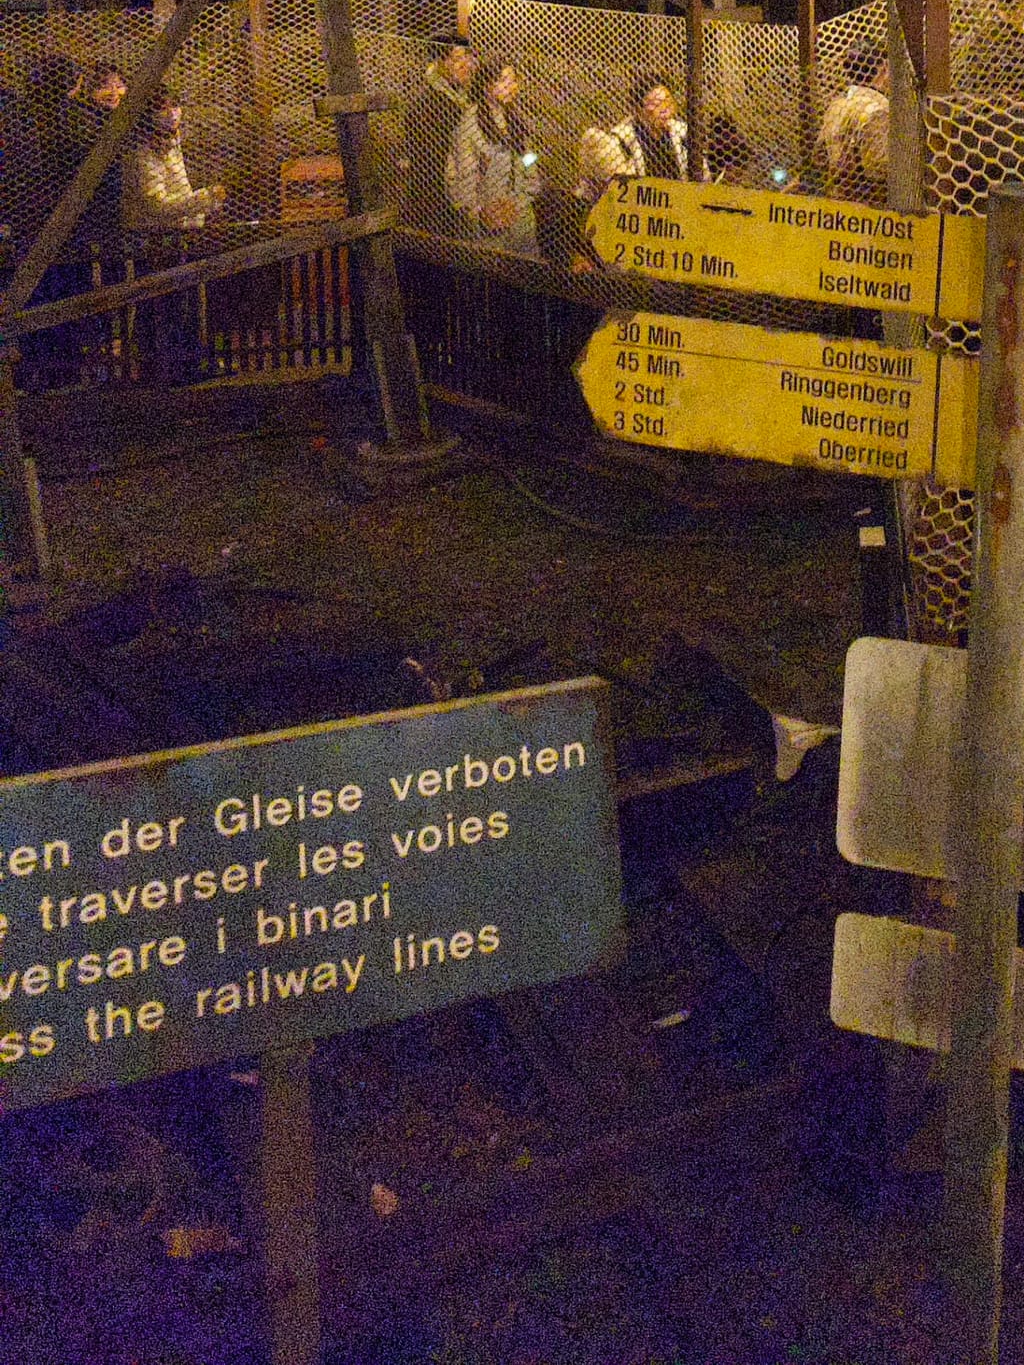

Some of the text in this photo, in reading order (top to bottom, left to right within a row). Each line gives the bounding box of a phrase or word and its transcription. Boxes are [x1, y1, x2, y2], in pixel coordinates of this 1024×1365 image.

[616, 181, 629, 204] 2
[768, 202, 915, 240] Interlaken/Ost
[616, 212, 640, 235] 40
[647, 215, 685, 240] Min.
[614, 243, 626, 264] 2
[671, 251, 694, 273] 10
[701, 254, 739, 279] Min.
[818, 267, 912, 303] Iseltwald
[616, 321, 641, 344] 30
[647, 324, 686, 349] Min.
[614, 380, 627, 403] 2
[801, 405, 910, 440] Niederried
[615, 350, 912, 410] 45 Min. Ringgenberg
[613, 410, 909, 471] 3 Std. Oberried
[101, 817, 187, 859] der
[214, 785, 364, 838] Gleise
[388, 741, 587, 802] verboten
[39, 857, 269, 932] traverser
[299, 841, 366, 880] les
[390, 810, 511, 858] voies
[216, 916, 227, 955] i
[257, 881, 392, 947] binari
[85, 1000, 166, 1044] the
[195, 954, 366, 1018] railway
[394, 924, 501, 975] lines
